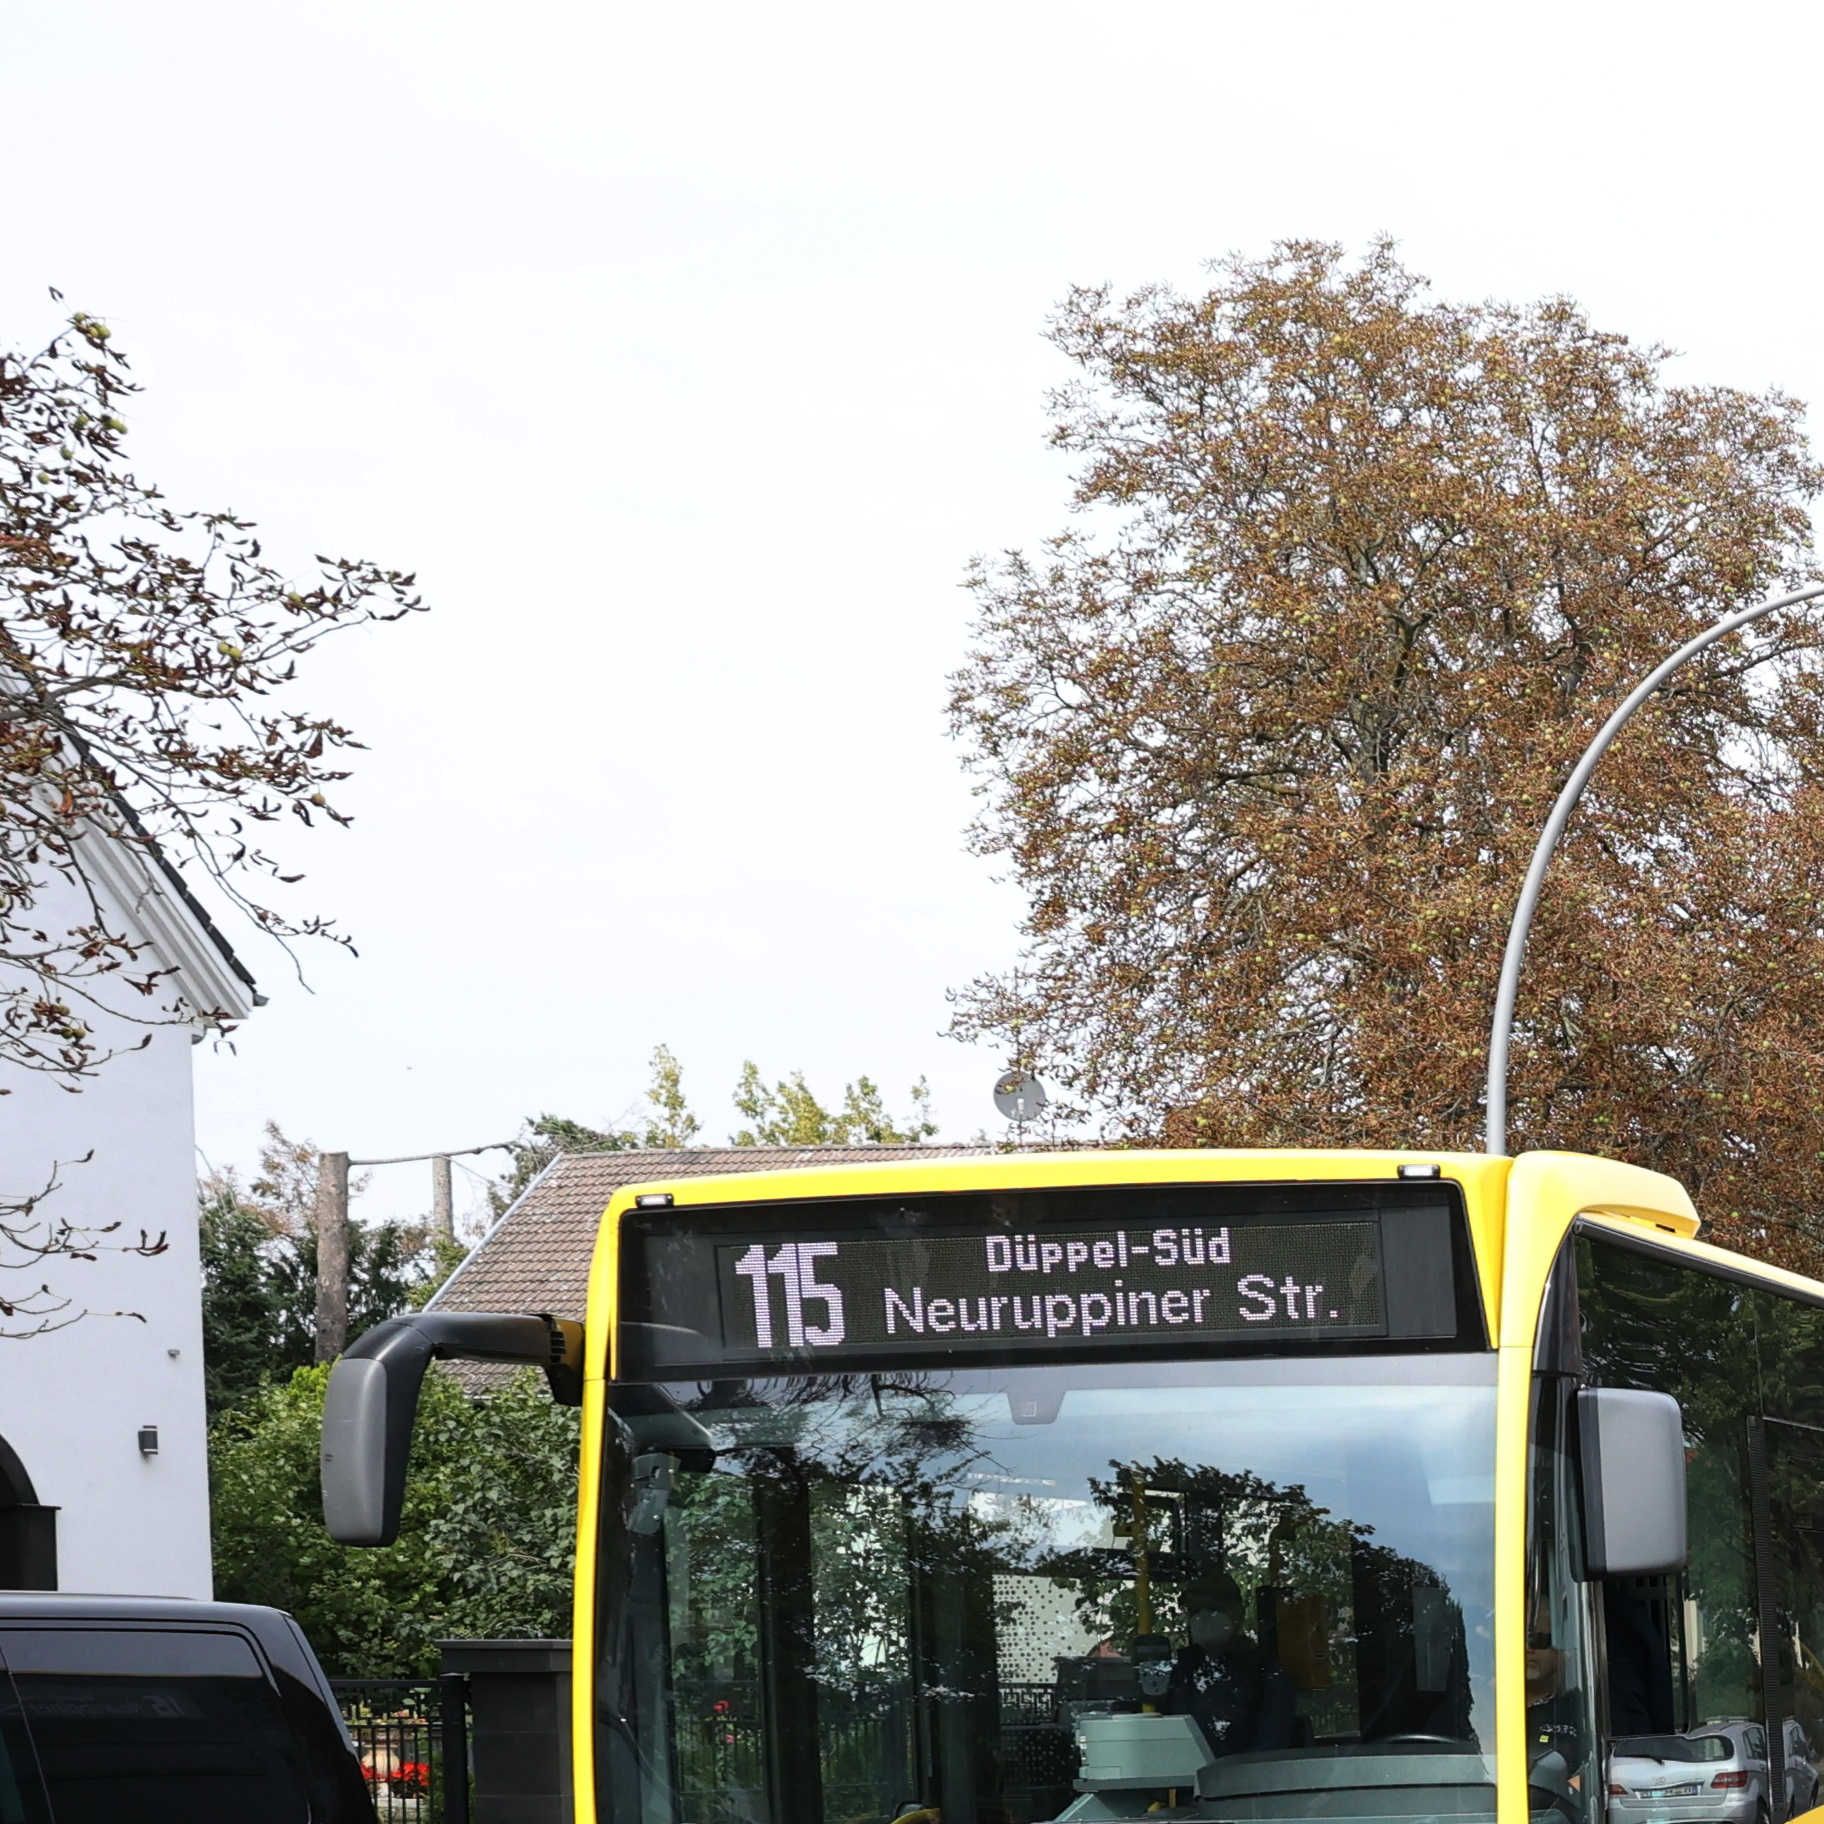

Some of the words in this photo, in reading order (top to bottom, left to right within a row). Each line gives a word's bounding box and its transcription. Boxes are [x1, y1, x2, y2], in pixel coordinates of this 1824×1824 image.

[986, 1227, 1231, 1274] Düppel-Süd
[735, 1242, 845, 1348] 115
[884, 1280, 1211, 1338] Neuruppiner
[1237, 1274, 1339, 1321] Str.
